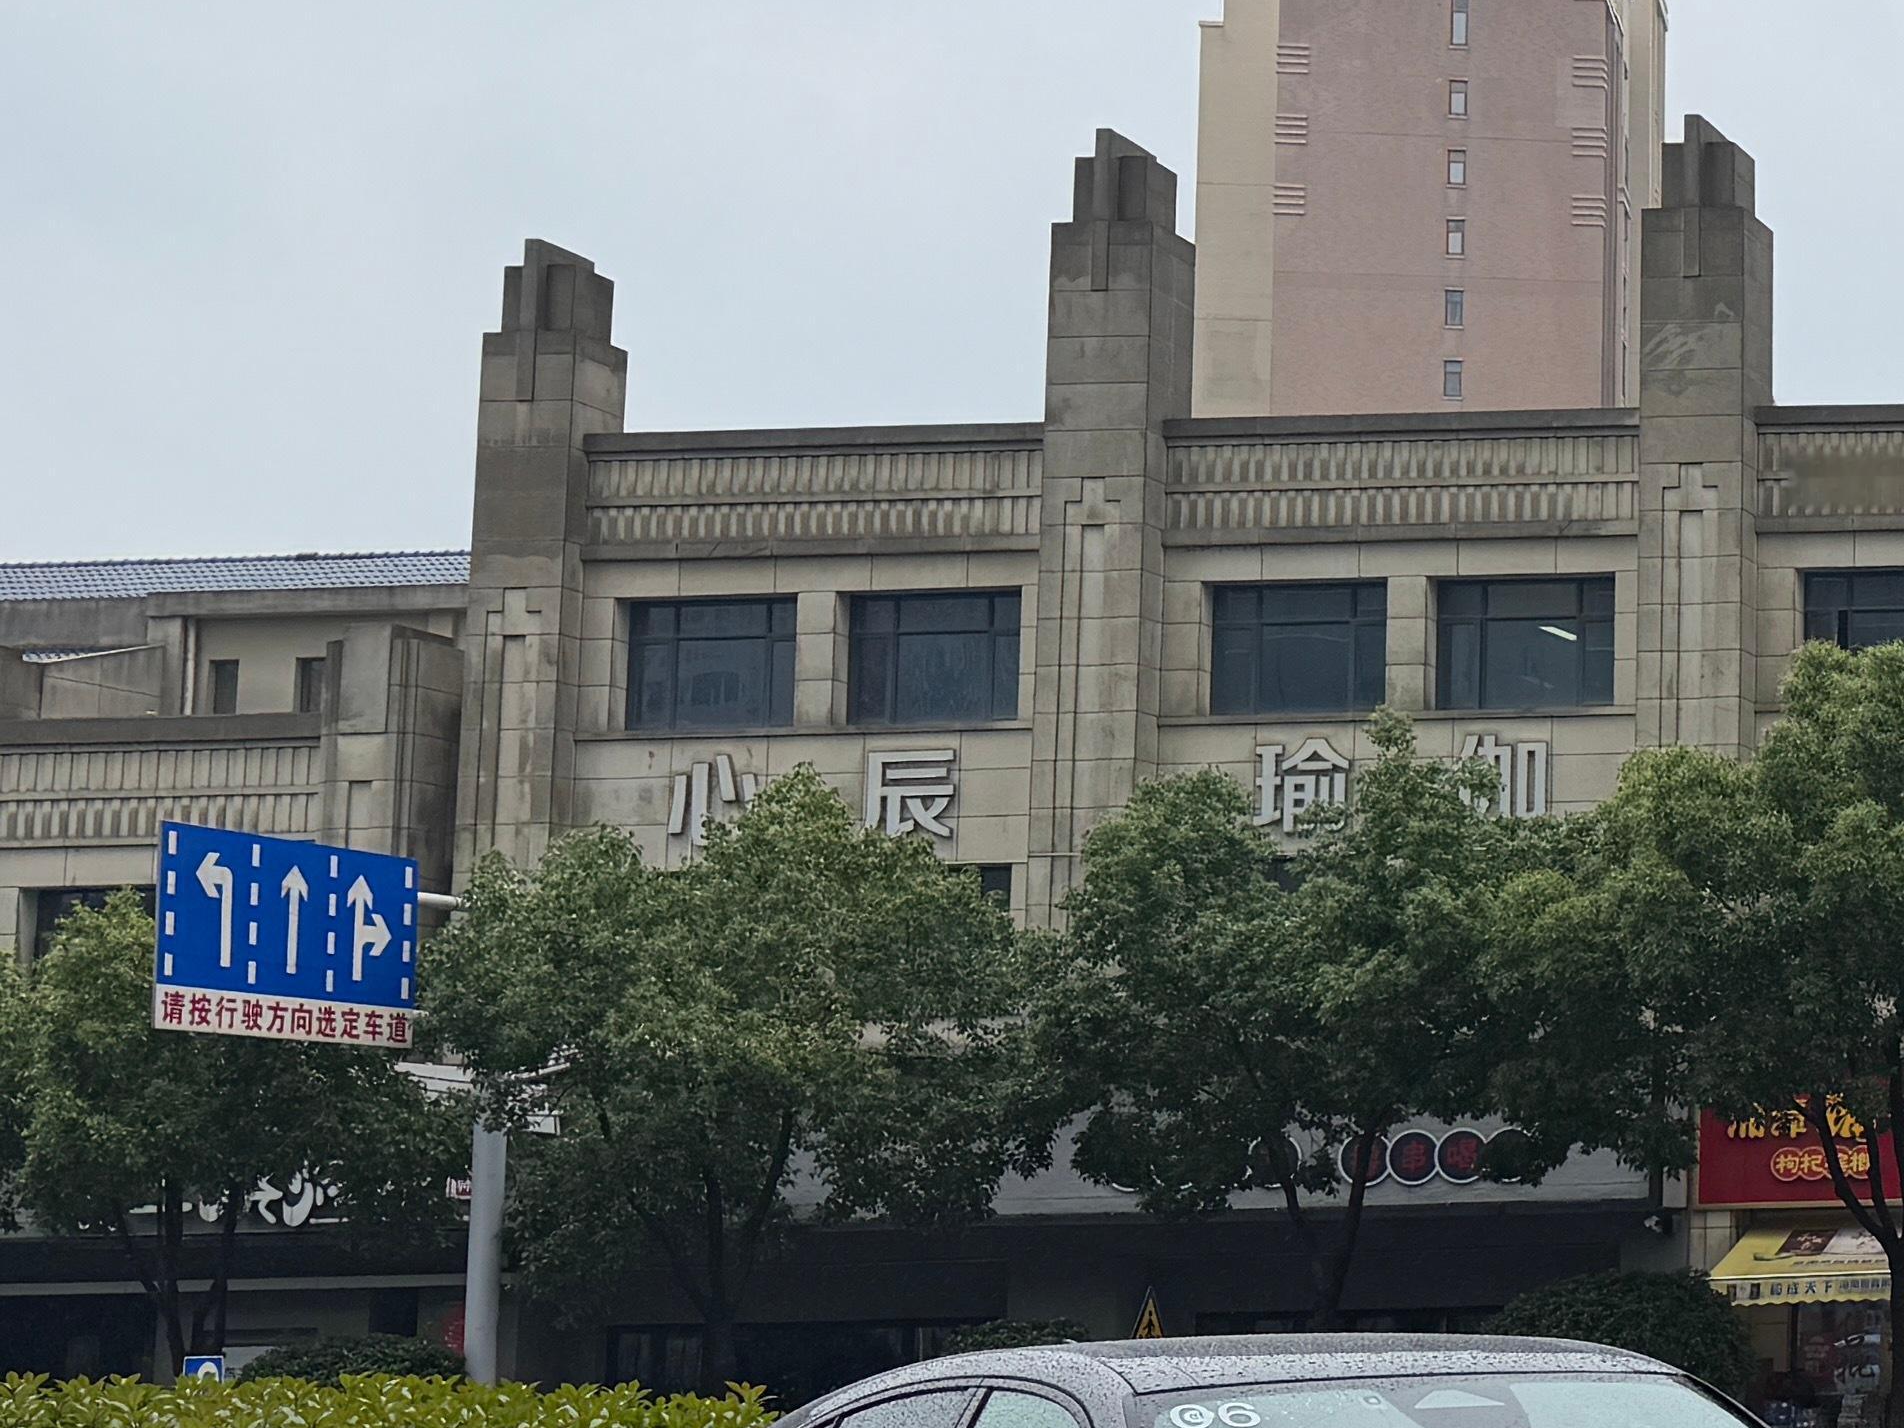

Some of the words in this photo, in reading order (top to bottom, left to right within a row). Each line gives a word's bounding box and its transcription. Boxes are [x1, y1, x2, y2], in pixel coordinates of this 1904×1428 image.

[161, 990, 410, 1044] 请按行驶方向选定车道
